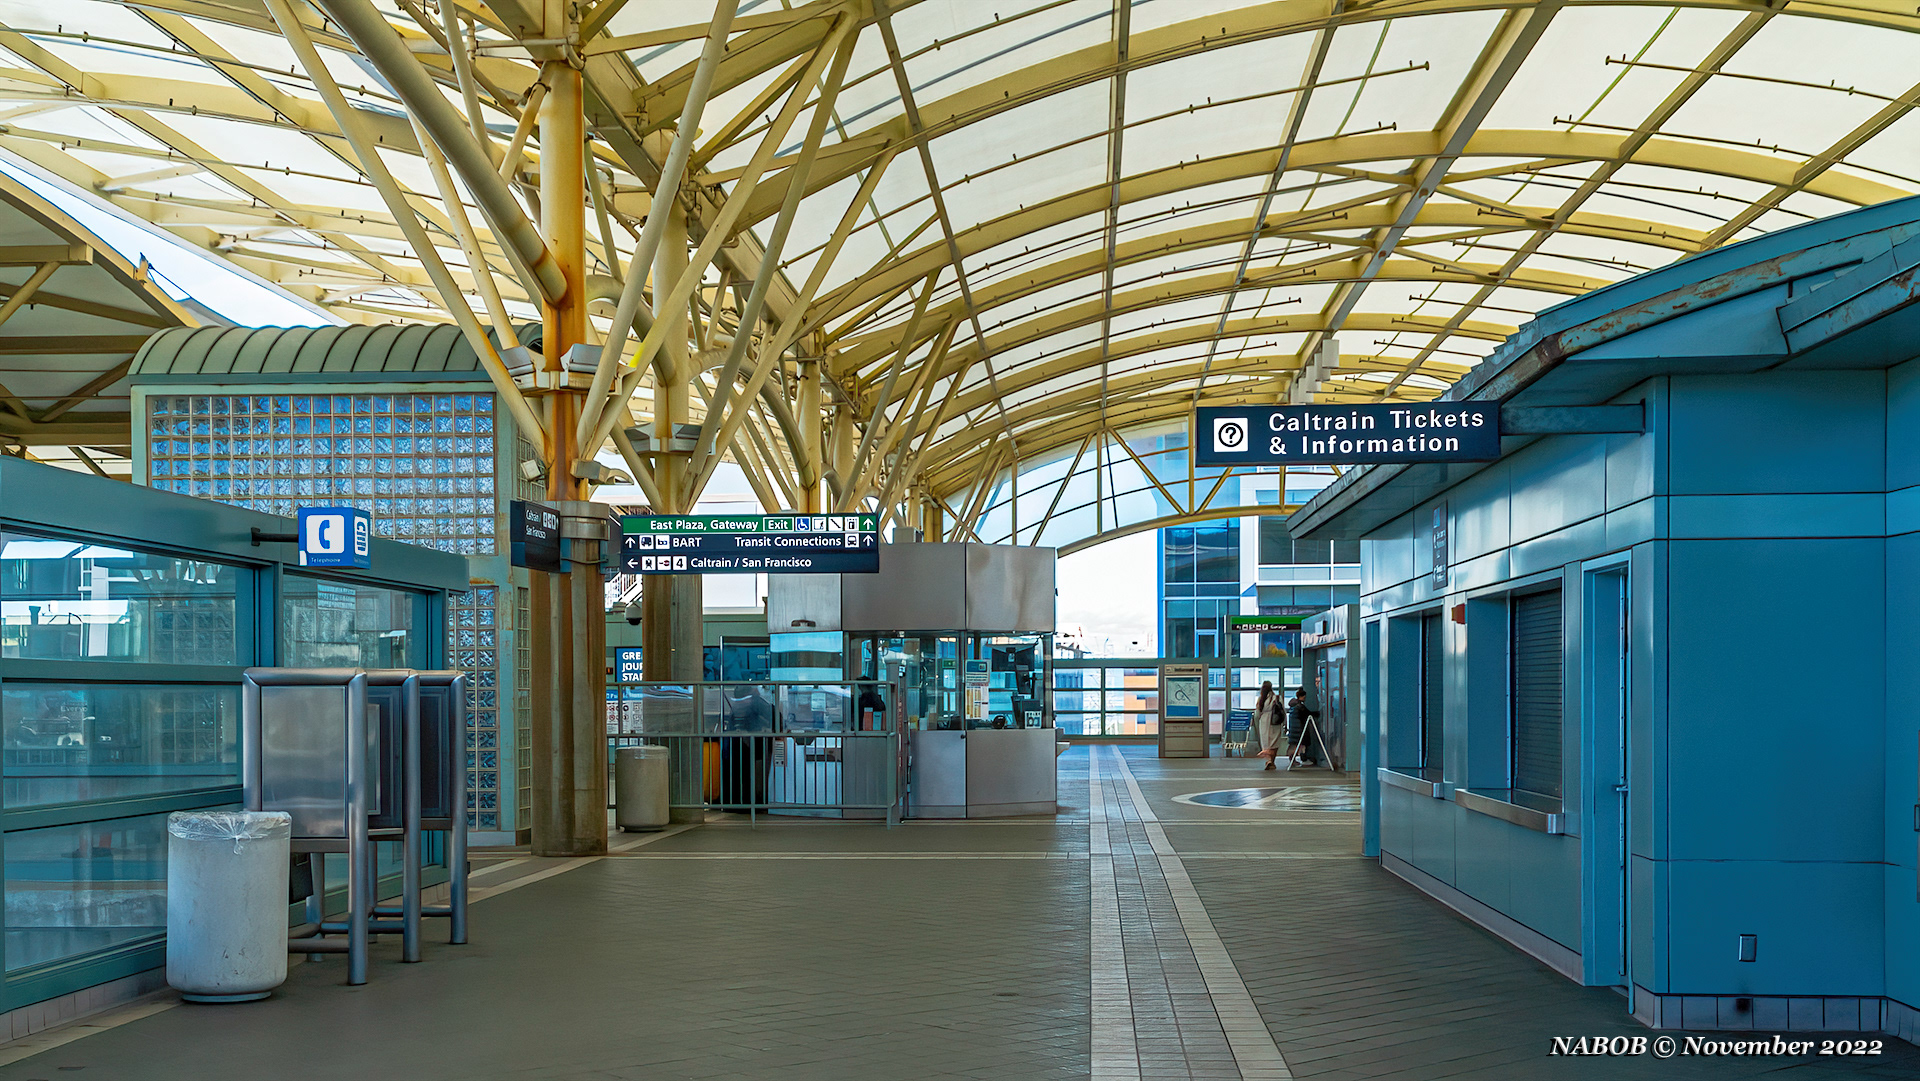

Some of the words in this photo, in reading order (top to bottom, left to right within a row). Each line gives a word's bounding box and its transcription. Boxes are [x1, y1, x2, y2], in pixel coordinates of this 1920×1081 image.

[1269, 411, 1375, 432] Caltrain
[1389, 409, 1484, 430] Tickets
[1269, 436, 1287, 455] &
[1302, 433, 1459, 455] Information
[650, 520, 673, 530] East
[675, 519, 707, 531] Plaza,
[710, 520, 758, 532] Gateway
[767, 519, 789, 530] Exit
[672, 536, 702, 548] BART
[734, 536, 771, 547] Transit
[773, 535, 842, 547] Connections
[690, 557, 732, 568] Caltrain
[742, 558, 762, 568] San
[764, 557, 812, 568] Francisco
[622, 651, 643, 661] GRE
